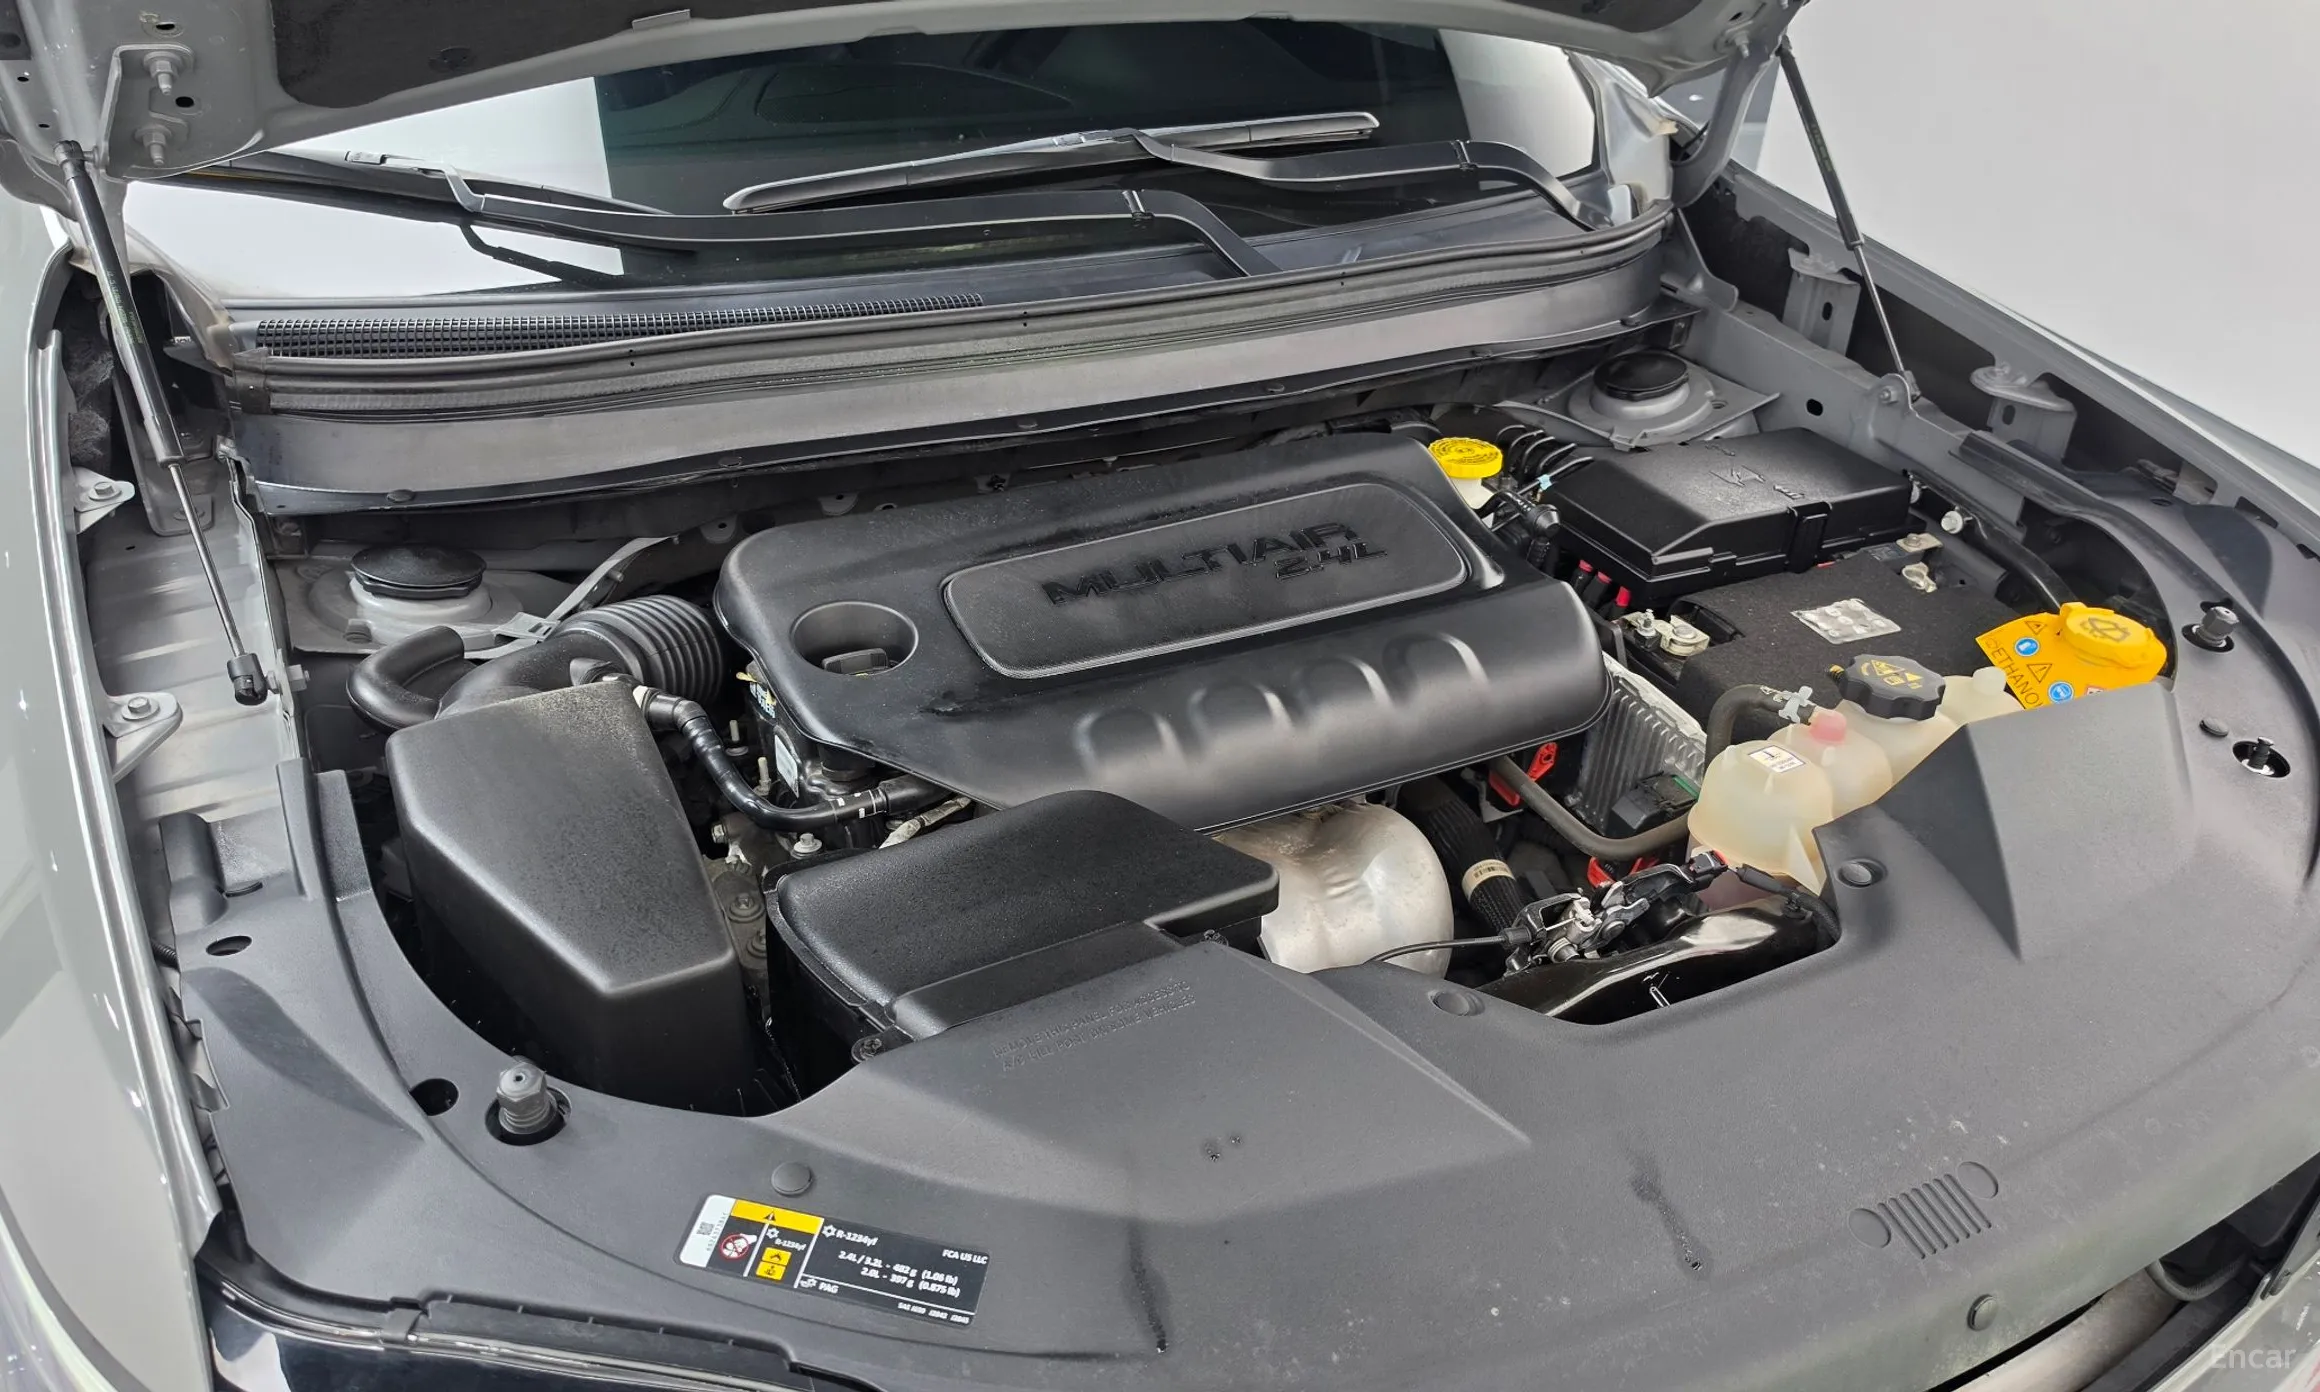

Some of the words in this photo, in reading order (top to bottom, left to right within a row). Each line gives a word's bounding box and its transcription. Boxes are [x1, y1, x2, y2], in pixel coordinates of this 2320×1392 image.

[1041, 522, 1361, 605] MULTIAIR
[1275, 540, 1388, 581] 2.4L
[1070, 1011, 1107, 1030] PANEL
[1109, 1001, 1132, 1016] FOR
[1144, 995, 1196, 1019] VEHICLES
[836, 1229, 879, 1247] R-1234yf
[838, 1250, 858, 1262] 2.4L
[864, 1256, 883, 1268] 3.2L
[909, 1268, 918, 1278] g
[944, 1275, 959, 1286] lb)
[942, 1249, 960, 1260] FCA
[959, 1252, 973, 1262] US
[972, 1254, 988, 1265] LLC
[818, 1281, 840, 1294] PAG
[906, 1279, 915, 1288] g
[946, 1286, 961, 1298] lb)
